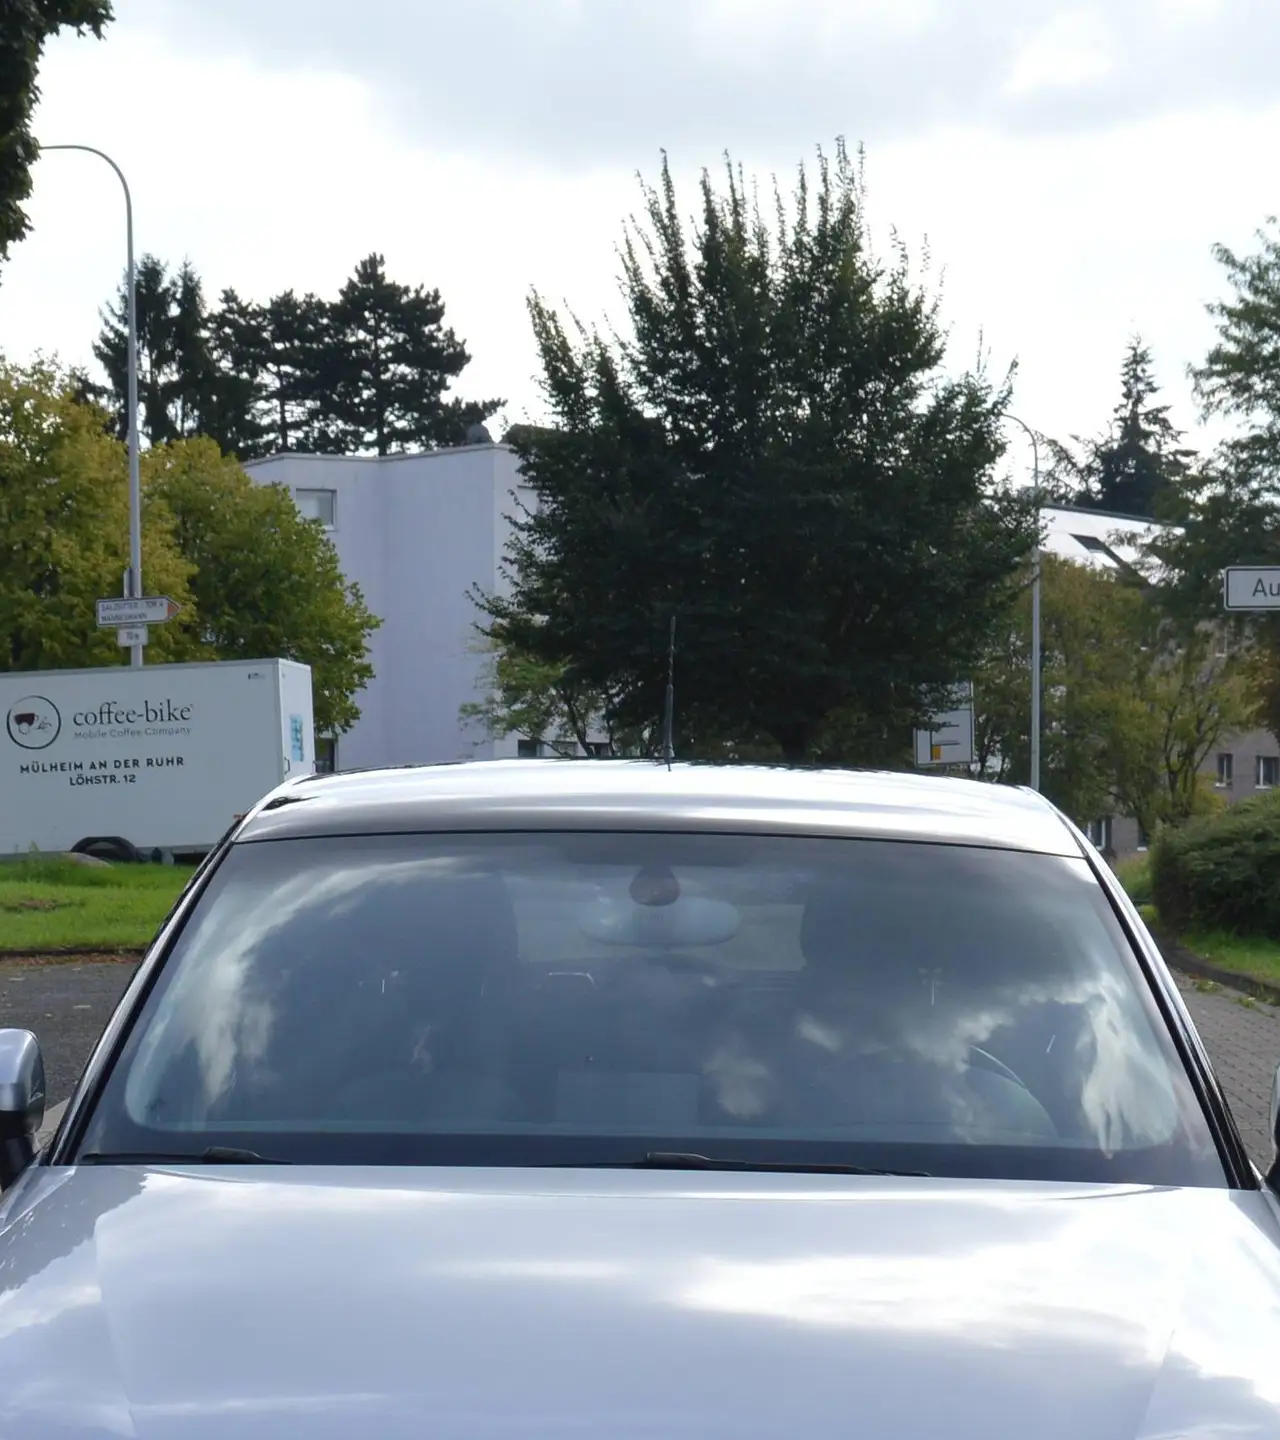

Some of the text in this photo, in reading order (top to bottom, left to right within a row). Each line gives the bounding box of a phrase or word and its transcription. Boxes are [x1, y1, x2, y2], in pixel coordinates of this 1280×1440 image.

[73, 698, 191, 727] coffee-bike
[109, 728, 142, 738] Coffee
[20, 756, 185, 774] MÜLHEIM AN DER RUHR
[69, 773, 136, 786] LÖHSTR. 12
